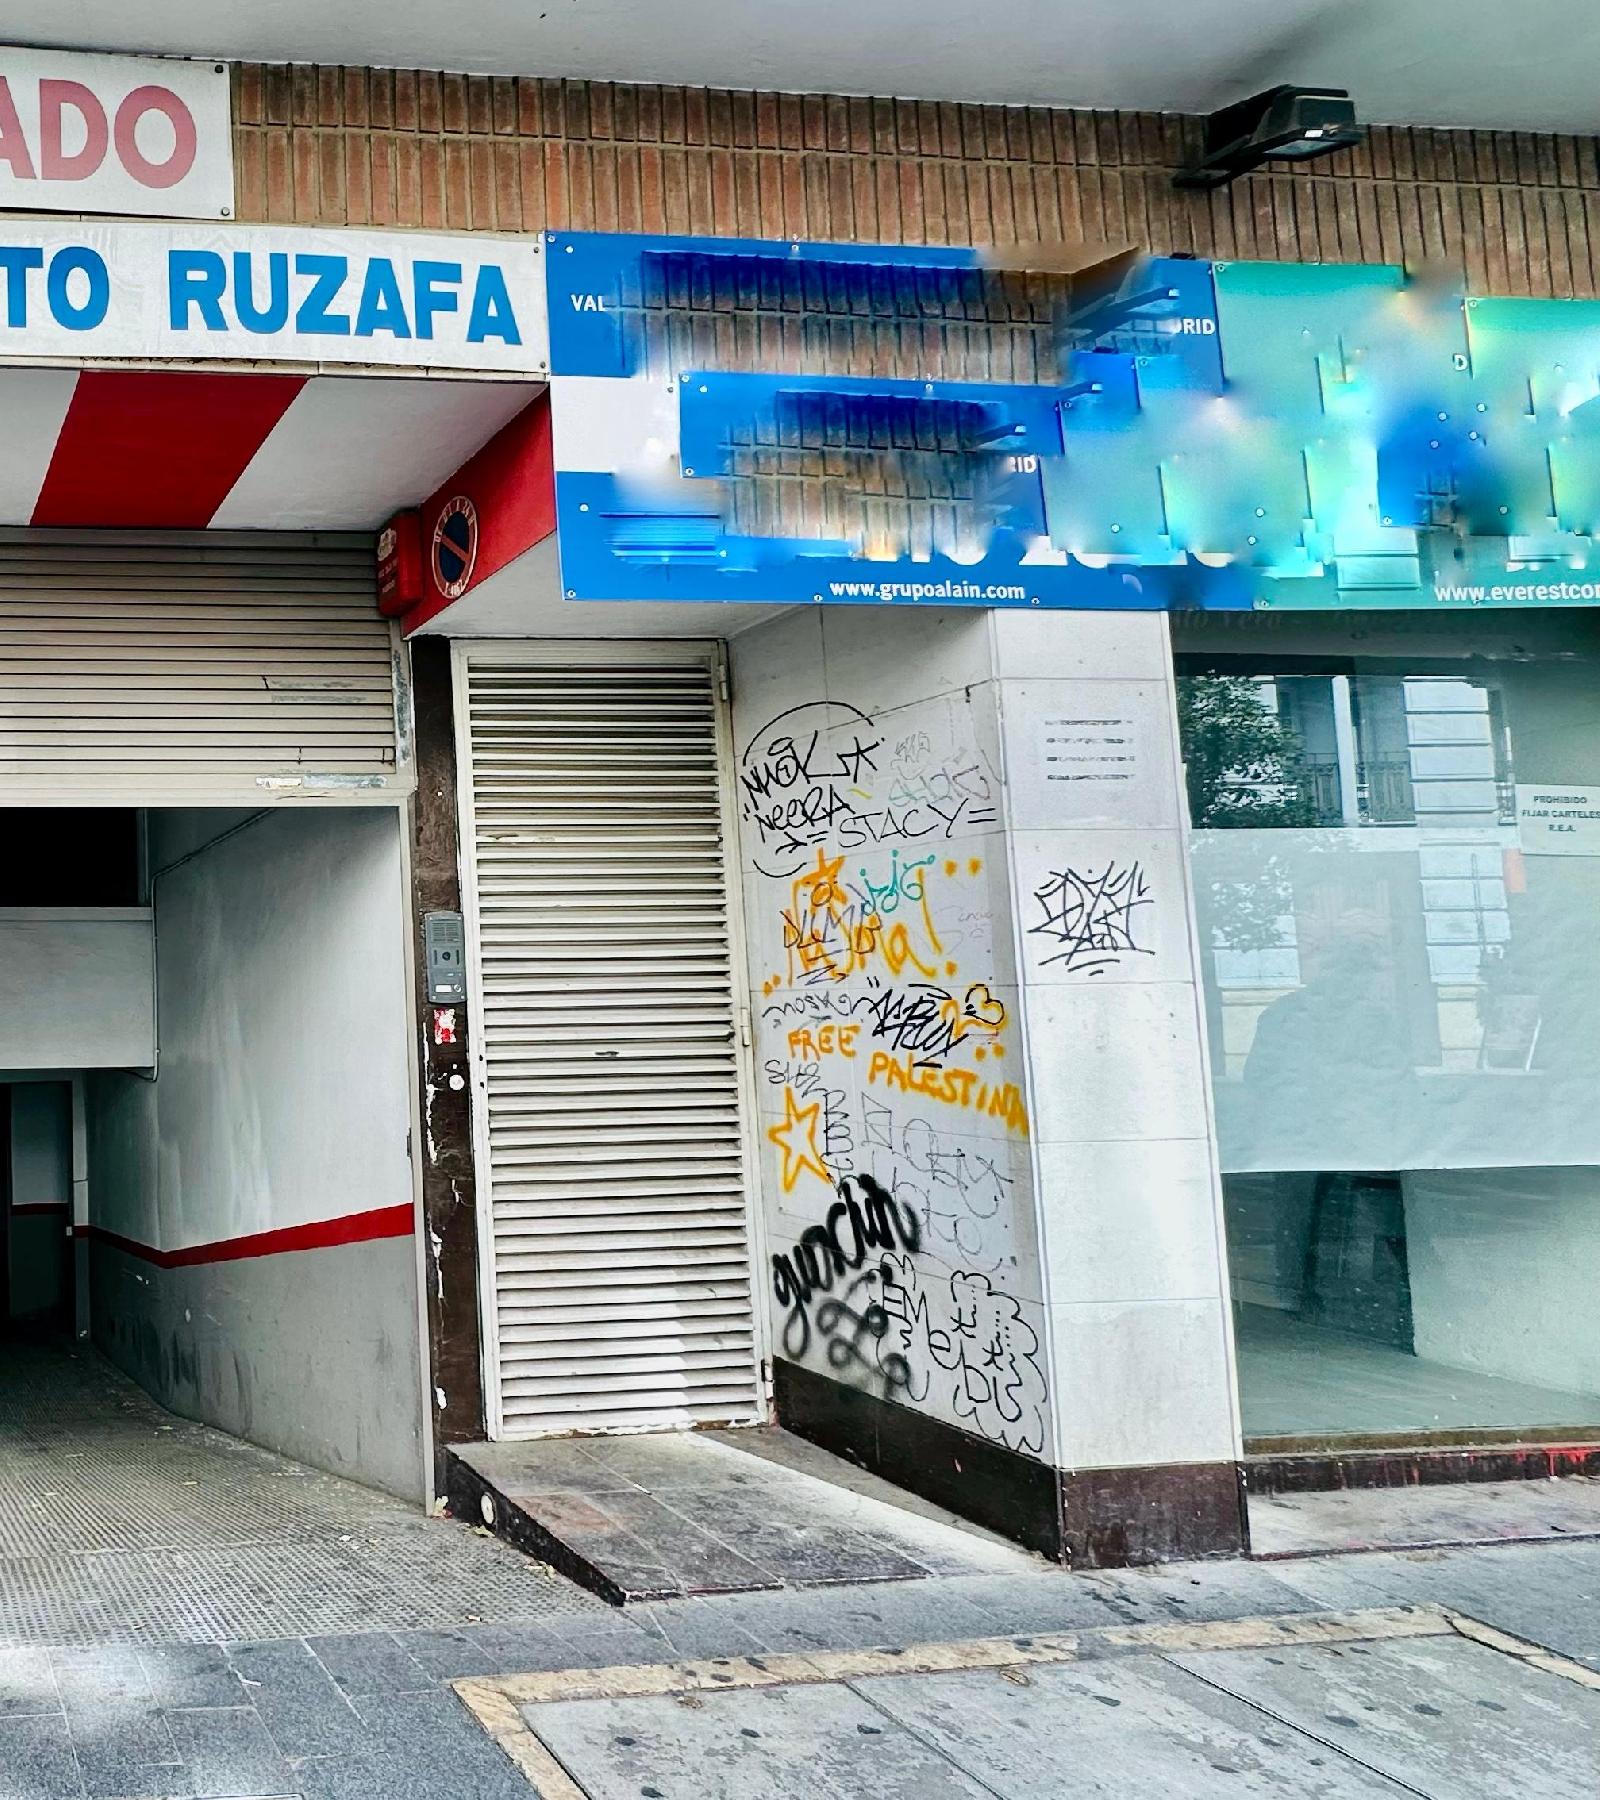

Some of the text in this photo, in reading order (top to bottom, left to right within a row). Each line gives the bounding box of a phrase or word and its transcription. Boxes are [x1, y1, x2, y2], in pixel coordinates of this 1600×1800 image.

[168, 249, 523, 347] RUZAFA
[829, 580, 1026, 601] www.grupoalain.com
[1533, 795, 1588, 804] PROHIBIDO
[1521, 809, 1549, 817] FIJAR
[1548, 824, 1577, 832] R.E.A.
[787, 1025, 862, 1062] FREE
